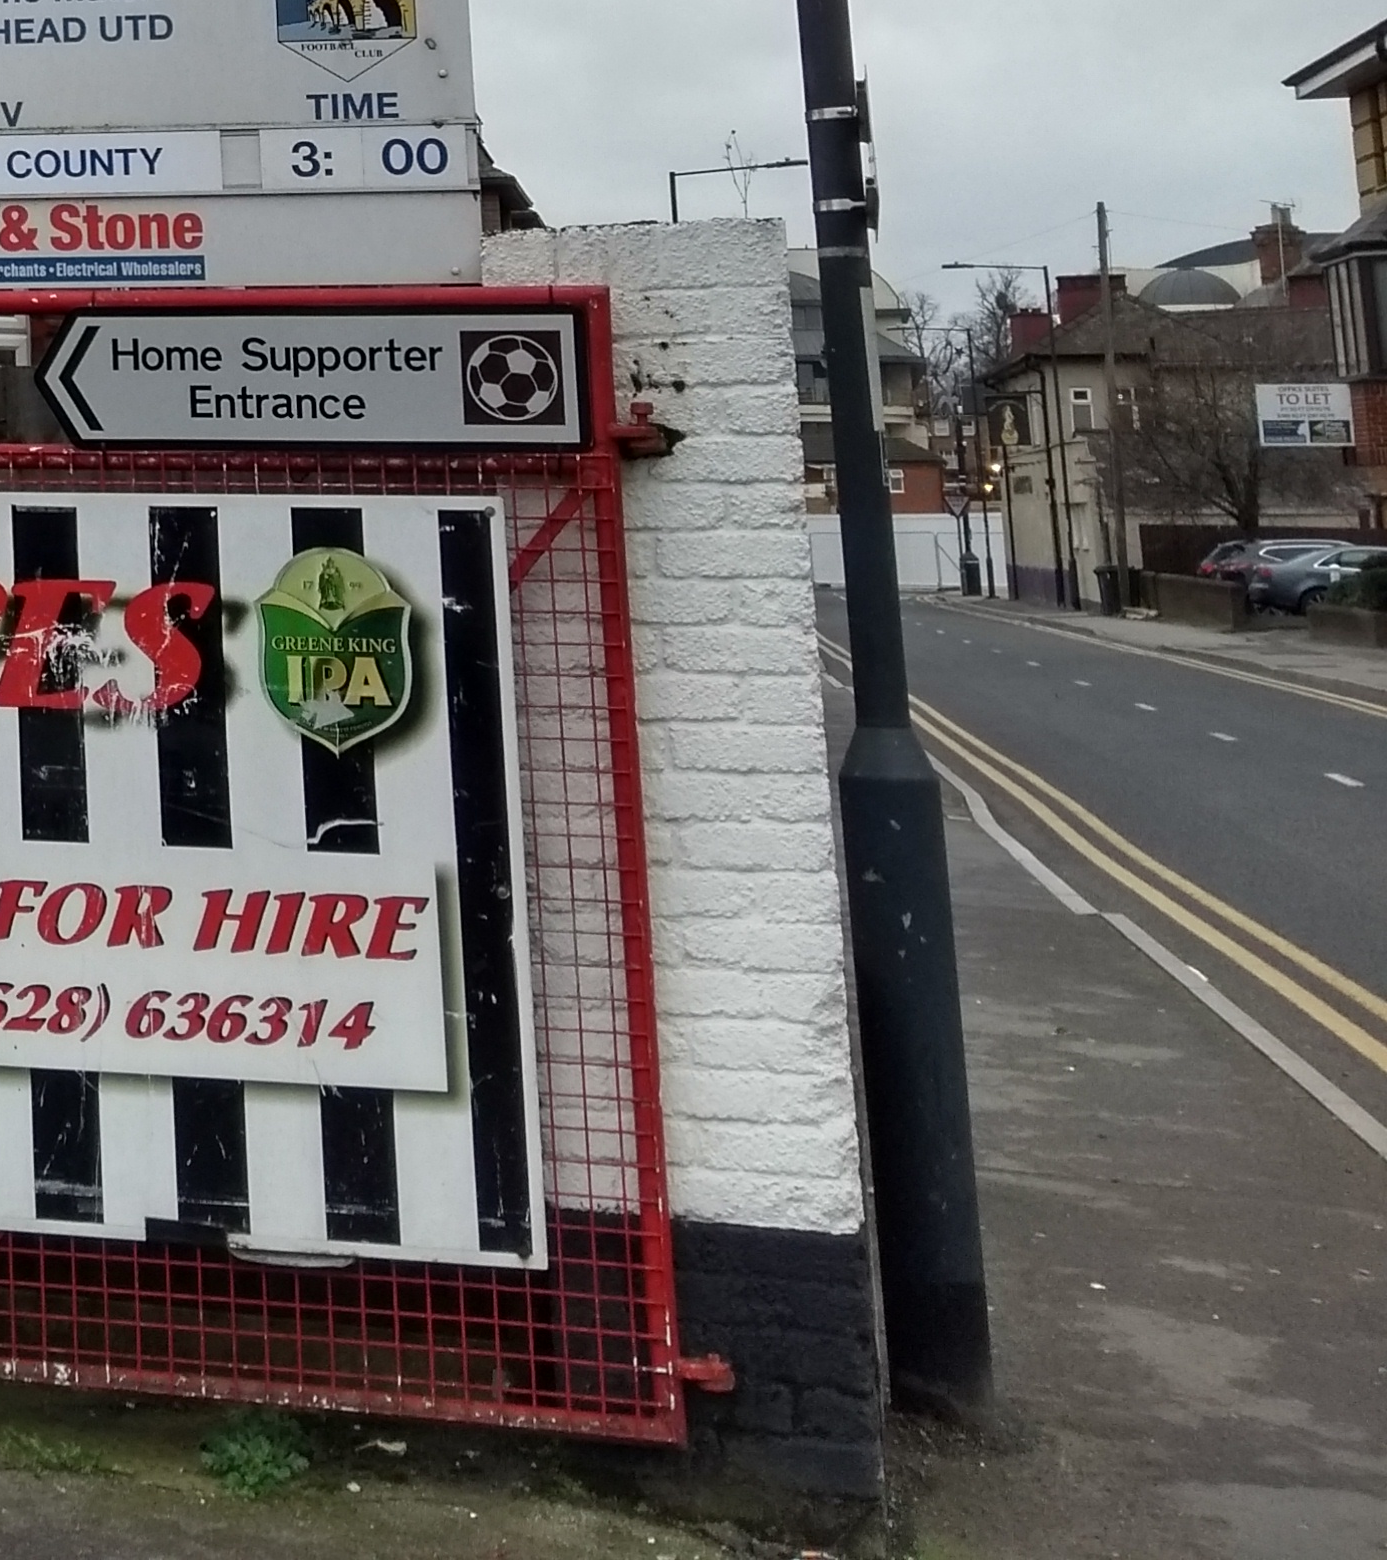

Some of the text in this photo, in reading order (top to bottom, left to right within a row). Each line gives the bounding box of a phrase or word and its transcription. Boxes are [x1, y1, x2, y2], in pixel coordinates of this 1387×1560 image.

[99, 14, 174, 42] UTD
[301, 43, 357, 52] FOOTBALL
[354, 49, 384, 58] CLUB
[306, 91, 399, 121] TIME
[6, 147, 163, 180] COUNTY
[291, 137, 449, 178] 3: 00
[49, 203, 204, 251] Stone
[56, 261, 117, 277] Electrical
[121, 260, 203, 277] Wholesalers
[111, 337, 443, 378] Home Supporter
[189, 385, 366, 420] Entrance
[1276, 393, 1332, 405] TO LET
[272, 635, 396, 654] GREENE KING
[287, 655, 393, 707] IPA
[193, 888, 430, 962] HIRE
[125, 989, 377, 1051] 636314
